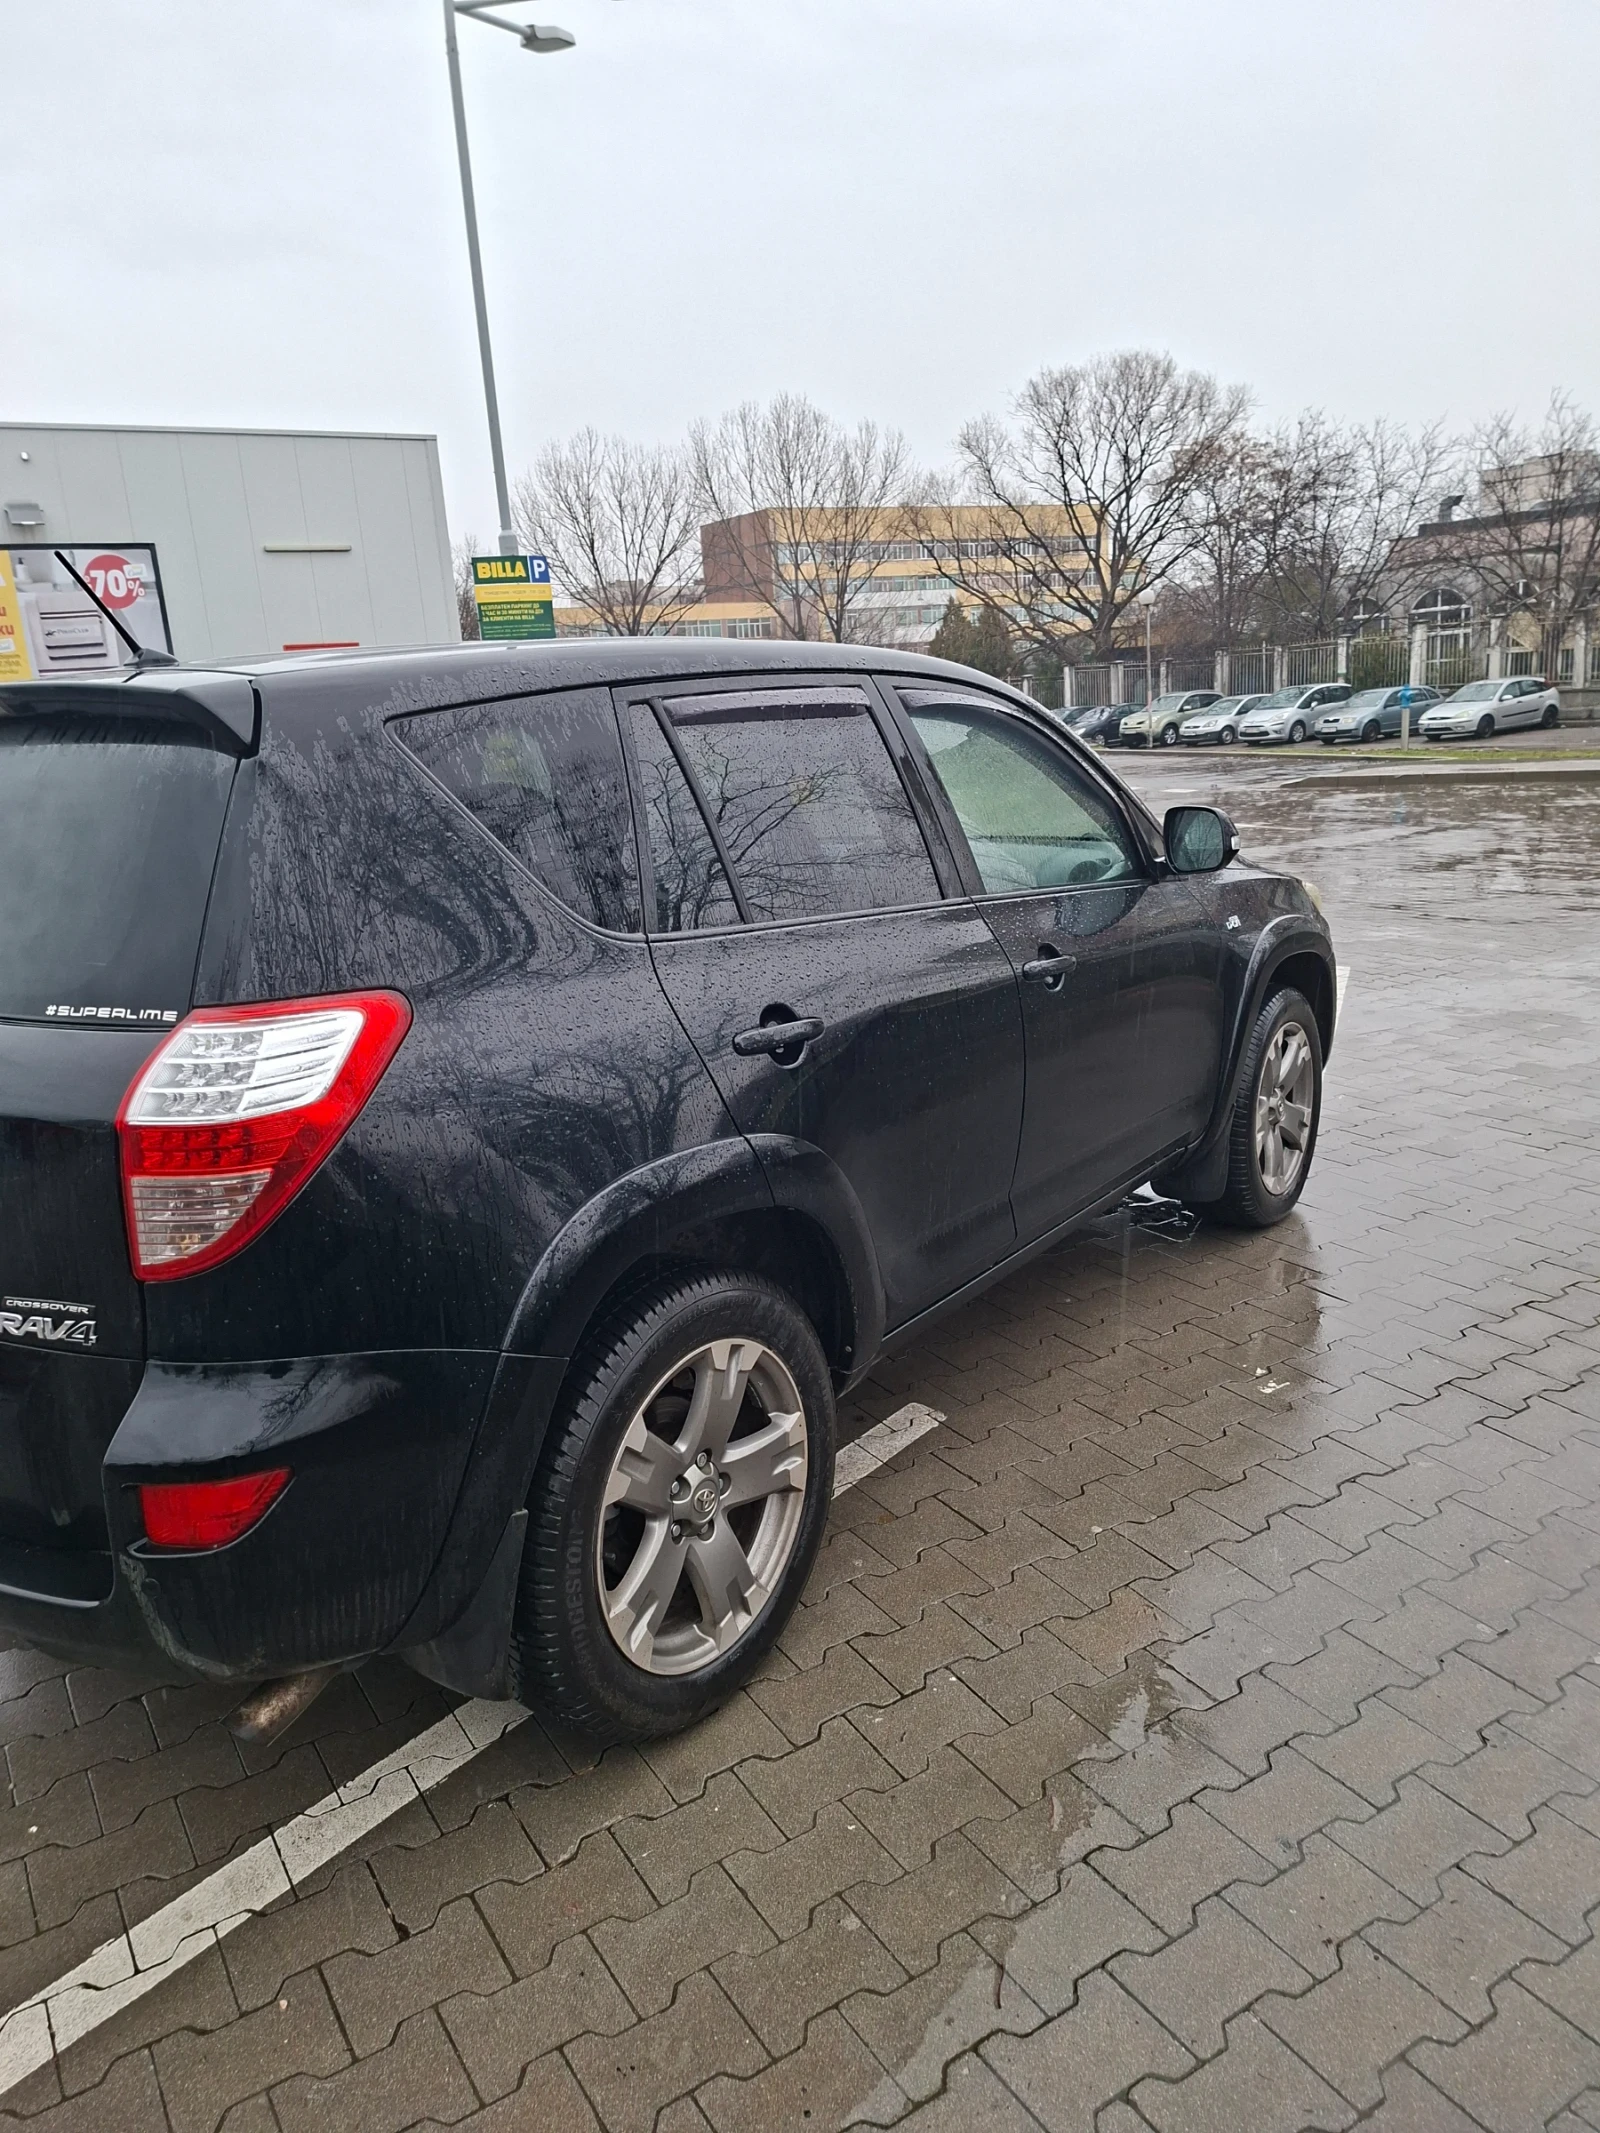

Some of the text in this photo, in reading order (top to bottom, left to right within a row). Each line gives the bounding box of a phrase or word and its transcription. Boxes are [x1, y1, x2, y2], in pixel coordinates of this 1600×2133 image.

[476, 559, 546, 578] BILLA P
[89, 569, 145, 598] 70%
[6, 1299, 89, 1314] CROSSOVER
[0, 1311, 98, 1346] RAV4
